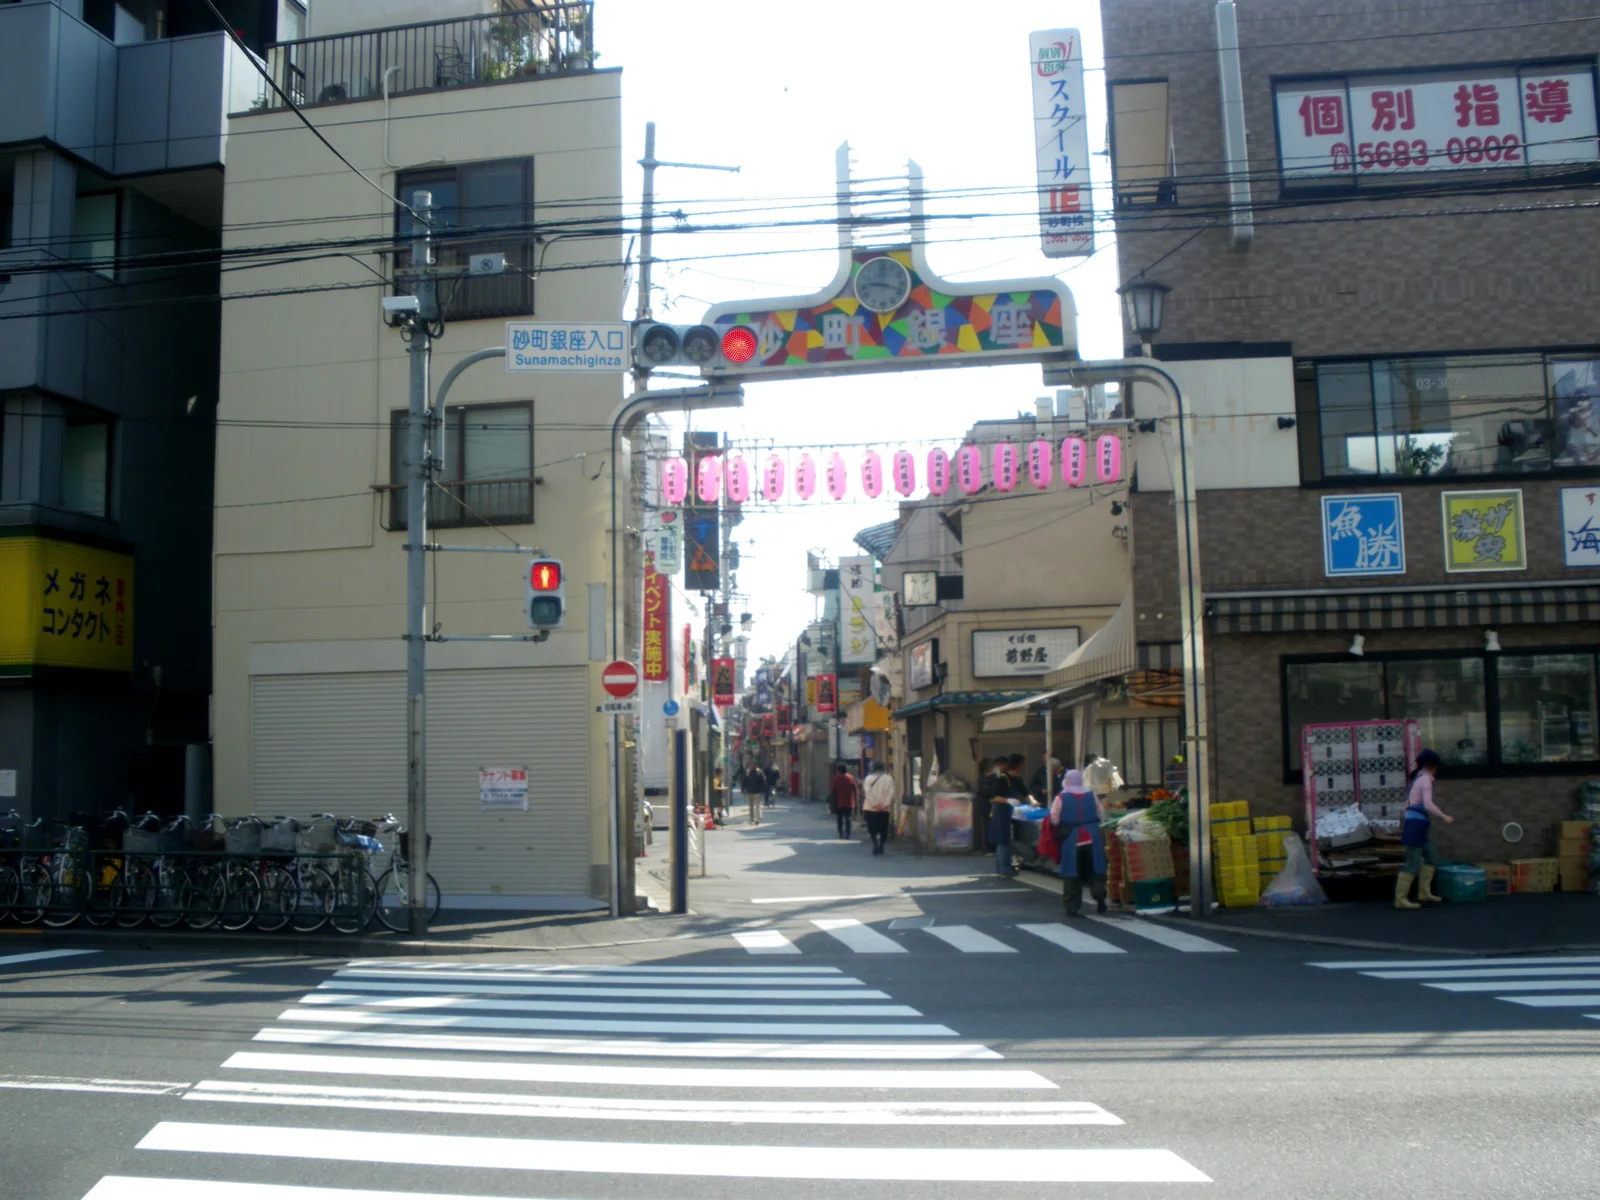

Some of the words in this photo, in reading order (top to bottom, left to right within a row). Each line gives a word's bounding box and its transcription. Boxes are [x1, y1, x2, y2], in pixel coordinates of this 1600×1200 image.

[1299, 79, 1573, 137] 個別指導
[1048, 79, 1076, 180] スクール
[1358, 134, 1521, 169] 5683-0802
[1050, 185, 1081, 213] IE
[512, 329, 623, 351] 砂町銀座入口
[515, 354, 621, 368] Sunamachiginza
[44, 568, 112, 607] メガネ
[42, 608, 111, 643] コンタクト
